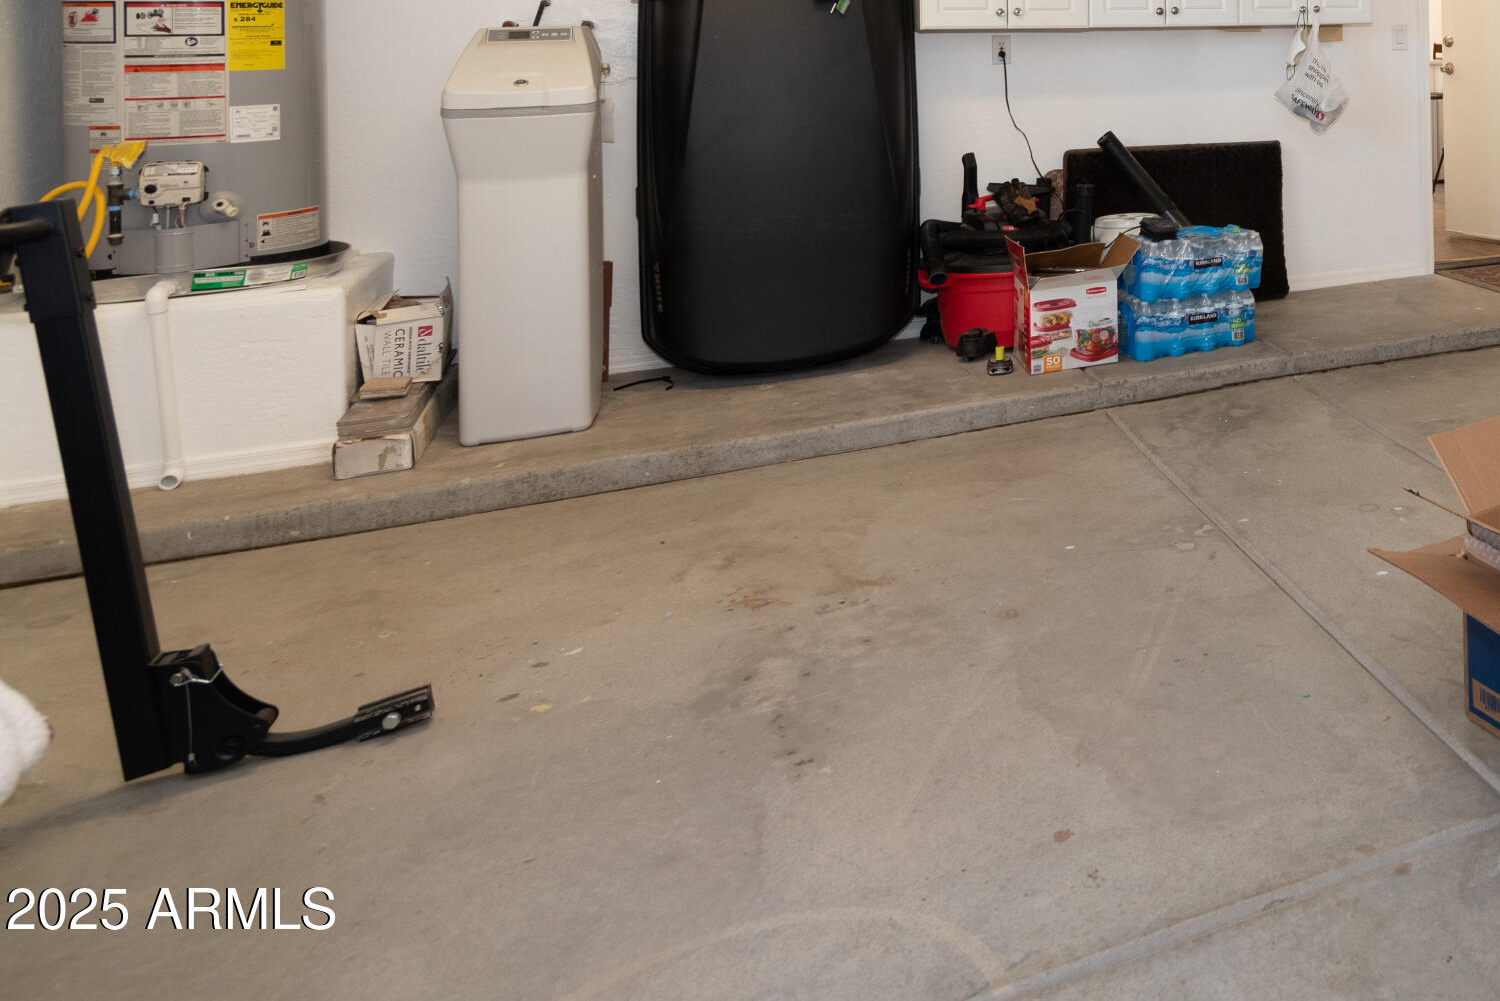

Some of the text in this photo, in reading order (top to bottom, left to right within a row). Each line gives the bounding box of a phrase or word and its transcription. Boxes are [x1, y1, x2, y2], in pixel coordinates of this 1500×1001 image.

[1291, 93, 1319, 115] SAFEWAY
[1189, 312, 1217, 322] KIRKLAND
[381, 331, 392, 376] WALL TILE
[393, 328, 406, 378] CERAMIC
[416, 338, 432, 373] daltile
[1046, 356, 1061, 366] 50
